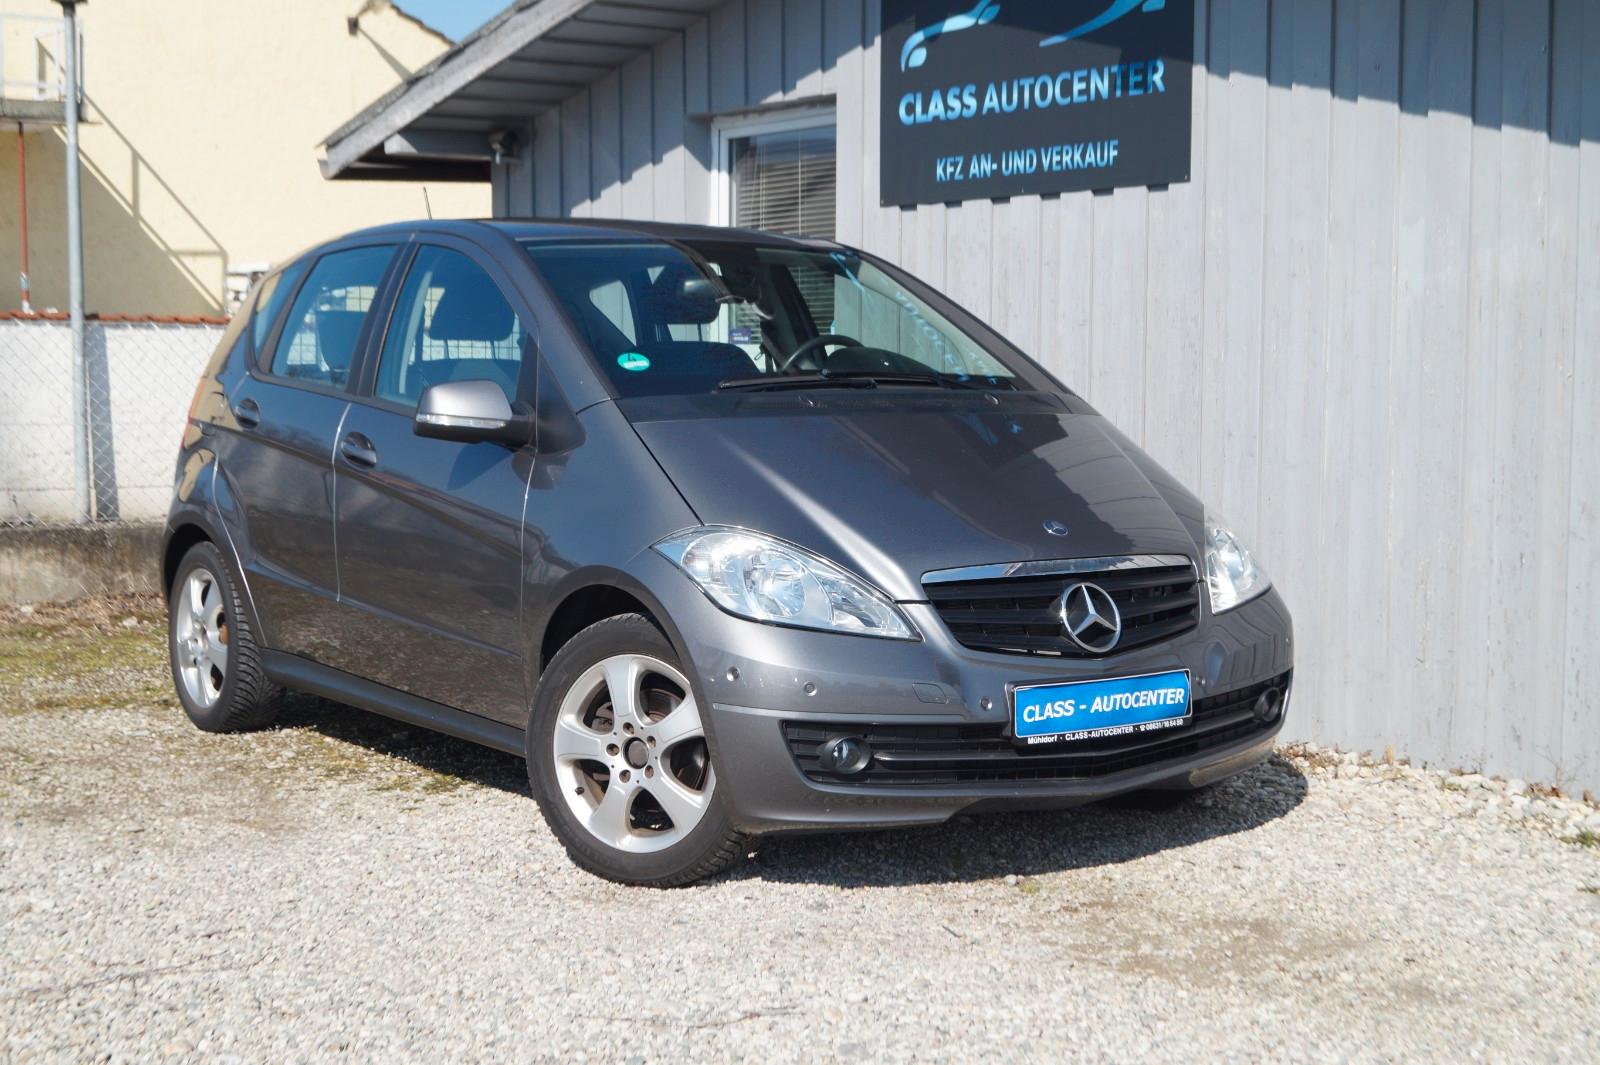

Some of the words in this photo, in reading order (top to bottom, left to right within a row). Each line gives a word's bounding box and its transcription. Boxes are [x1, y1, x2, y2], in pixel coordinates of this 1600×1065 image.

[899, 83, 978, 125] CLASS
[982, 58, 1165, 115] AUTOCENTER
[935, 154, 965, 183] KFZ
[968, 152, 998, 179] AN-
[1001, 148, 1037, 177] UND
[1040, 138, 1119, 173] VERKAUF
[1024, 700, 1074, 723] CLASS
[1091, 688, 1184, 713] AUTOCENTER
[1027, 735, 1058, 745] Mühldorf
[1065, 726, 1133, 740] CLASS-AUTOCENTER
